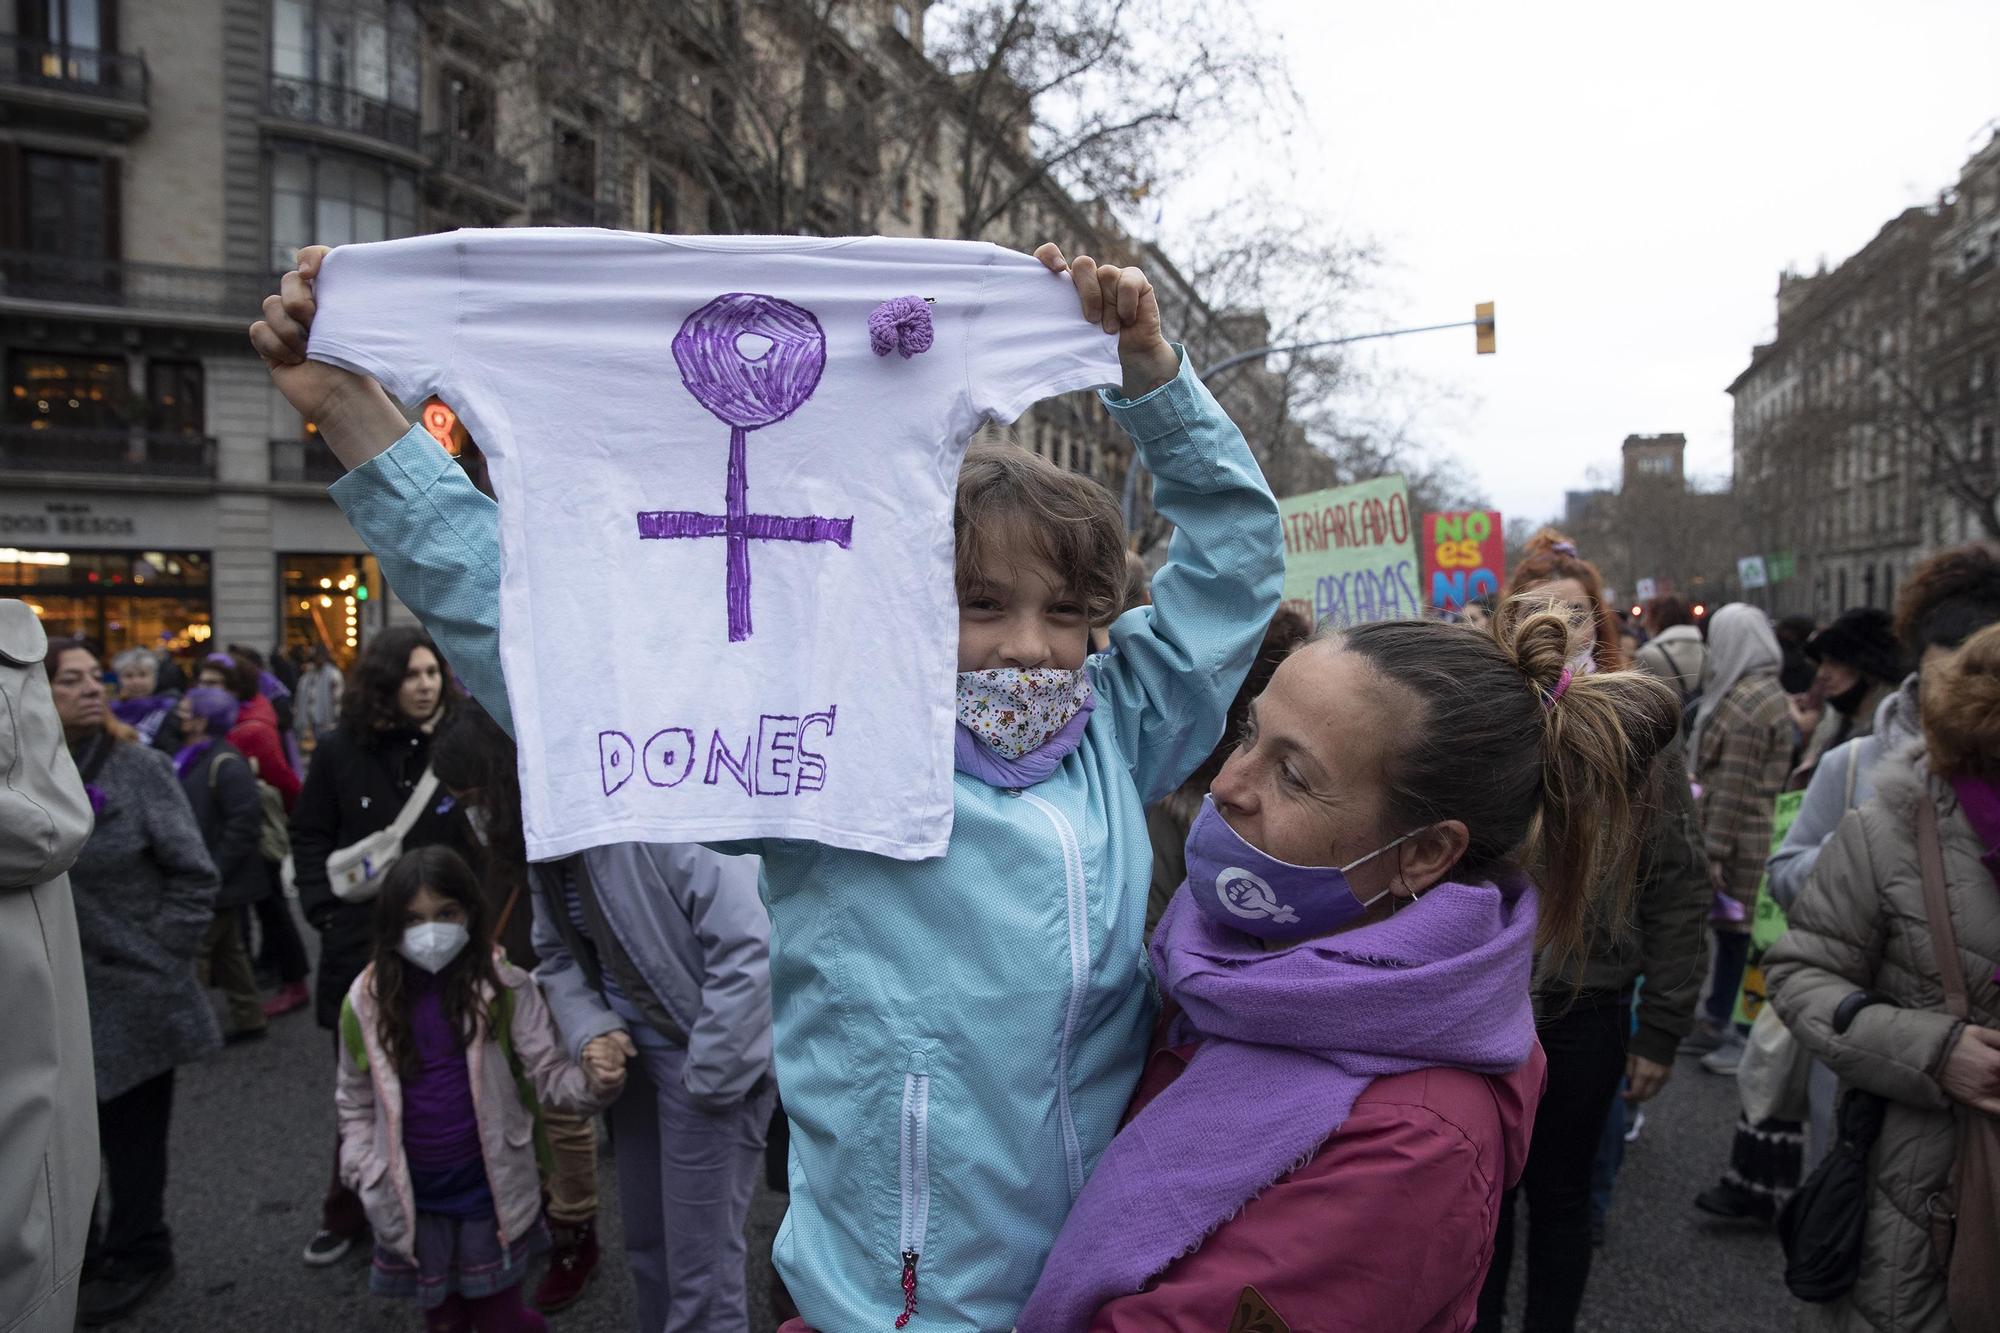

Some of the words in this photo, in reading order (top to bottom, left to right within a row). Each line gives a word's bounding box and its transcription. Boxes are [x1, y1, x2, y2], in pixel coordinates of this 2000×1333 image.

[1435, 512, 1490, 544] NO
[1435, 540, 1482, 568] es
[1432, 568, 1498, 607] NO
[598, 704, 837, 797] DONES
